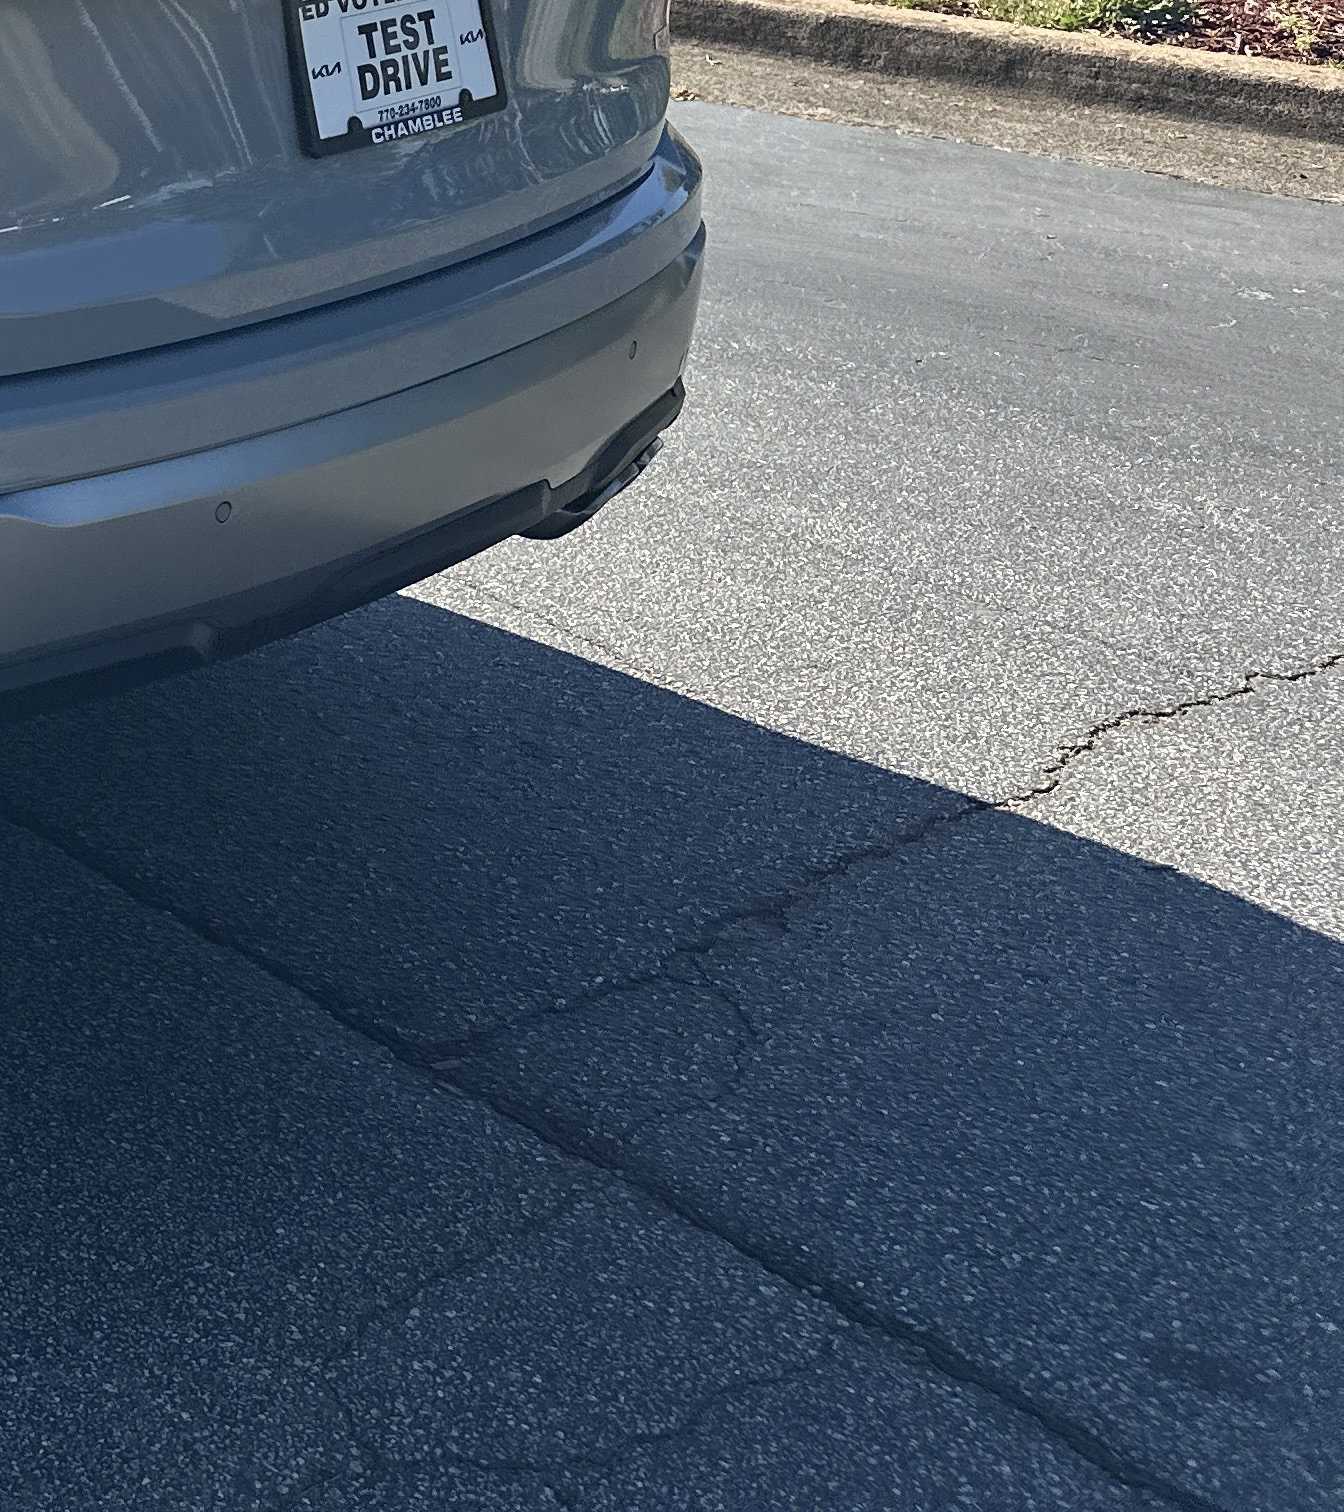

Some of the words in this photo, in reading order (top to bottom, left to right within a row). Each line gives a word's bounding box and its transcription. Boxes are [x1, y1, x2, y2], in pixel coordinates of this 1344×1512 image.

[301, 3, 330, 21] ED
[357, 8, 436, 59] TEST
[356, 45, 453, 101] DRIVE
[371, 106, 464, 144] CHAMBLEE
[377, 95, 442, 123] 770-234-7800
